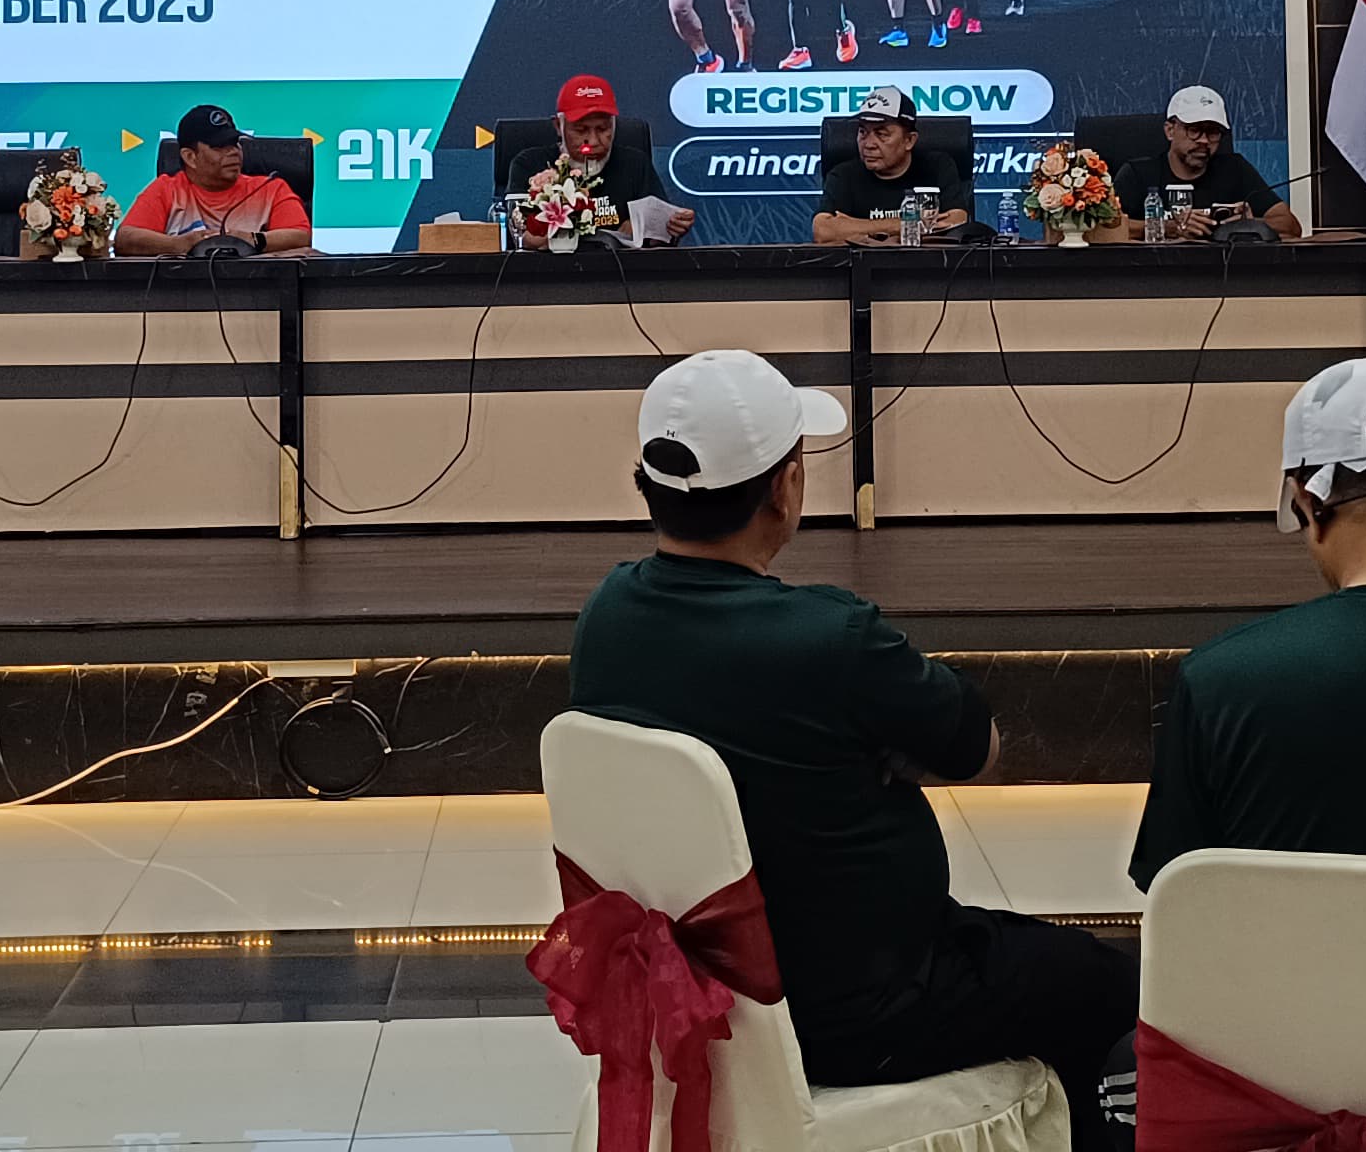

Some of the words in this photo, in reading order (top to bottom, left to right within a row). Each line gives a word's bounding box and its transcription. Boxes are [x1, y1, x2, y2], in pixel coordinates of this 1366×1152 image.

[707, 86, 885, 113] REGISTE
[912, 84, 1018, 112] NOW
[338, 128, 433, 181] 21K
